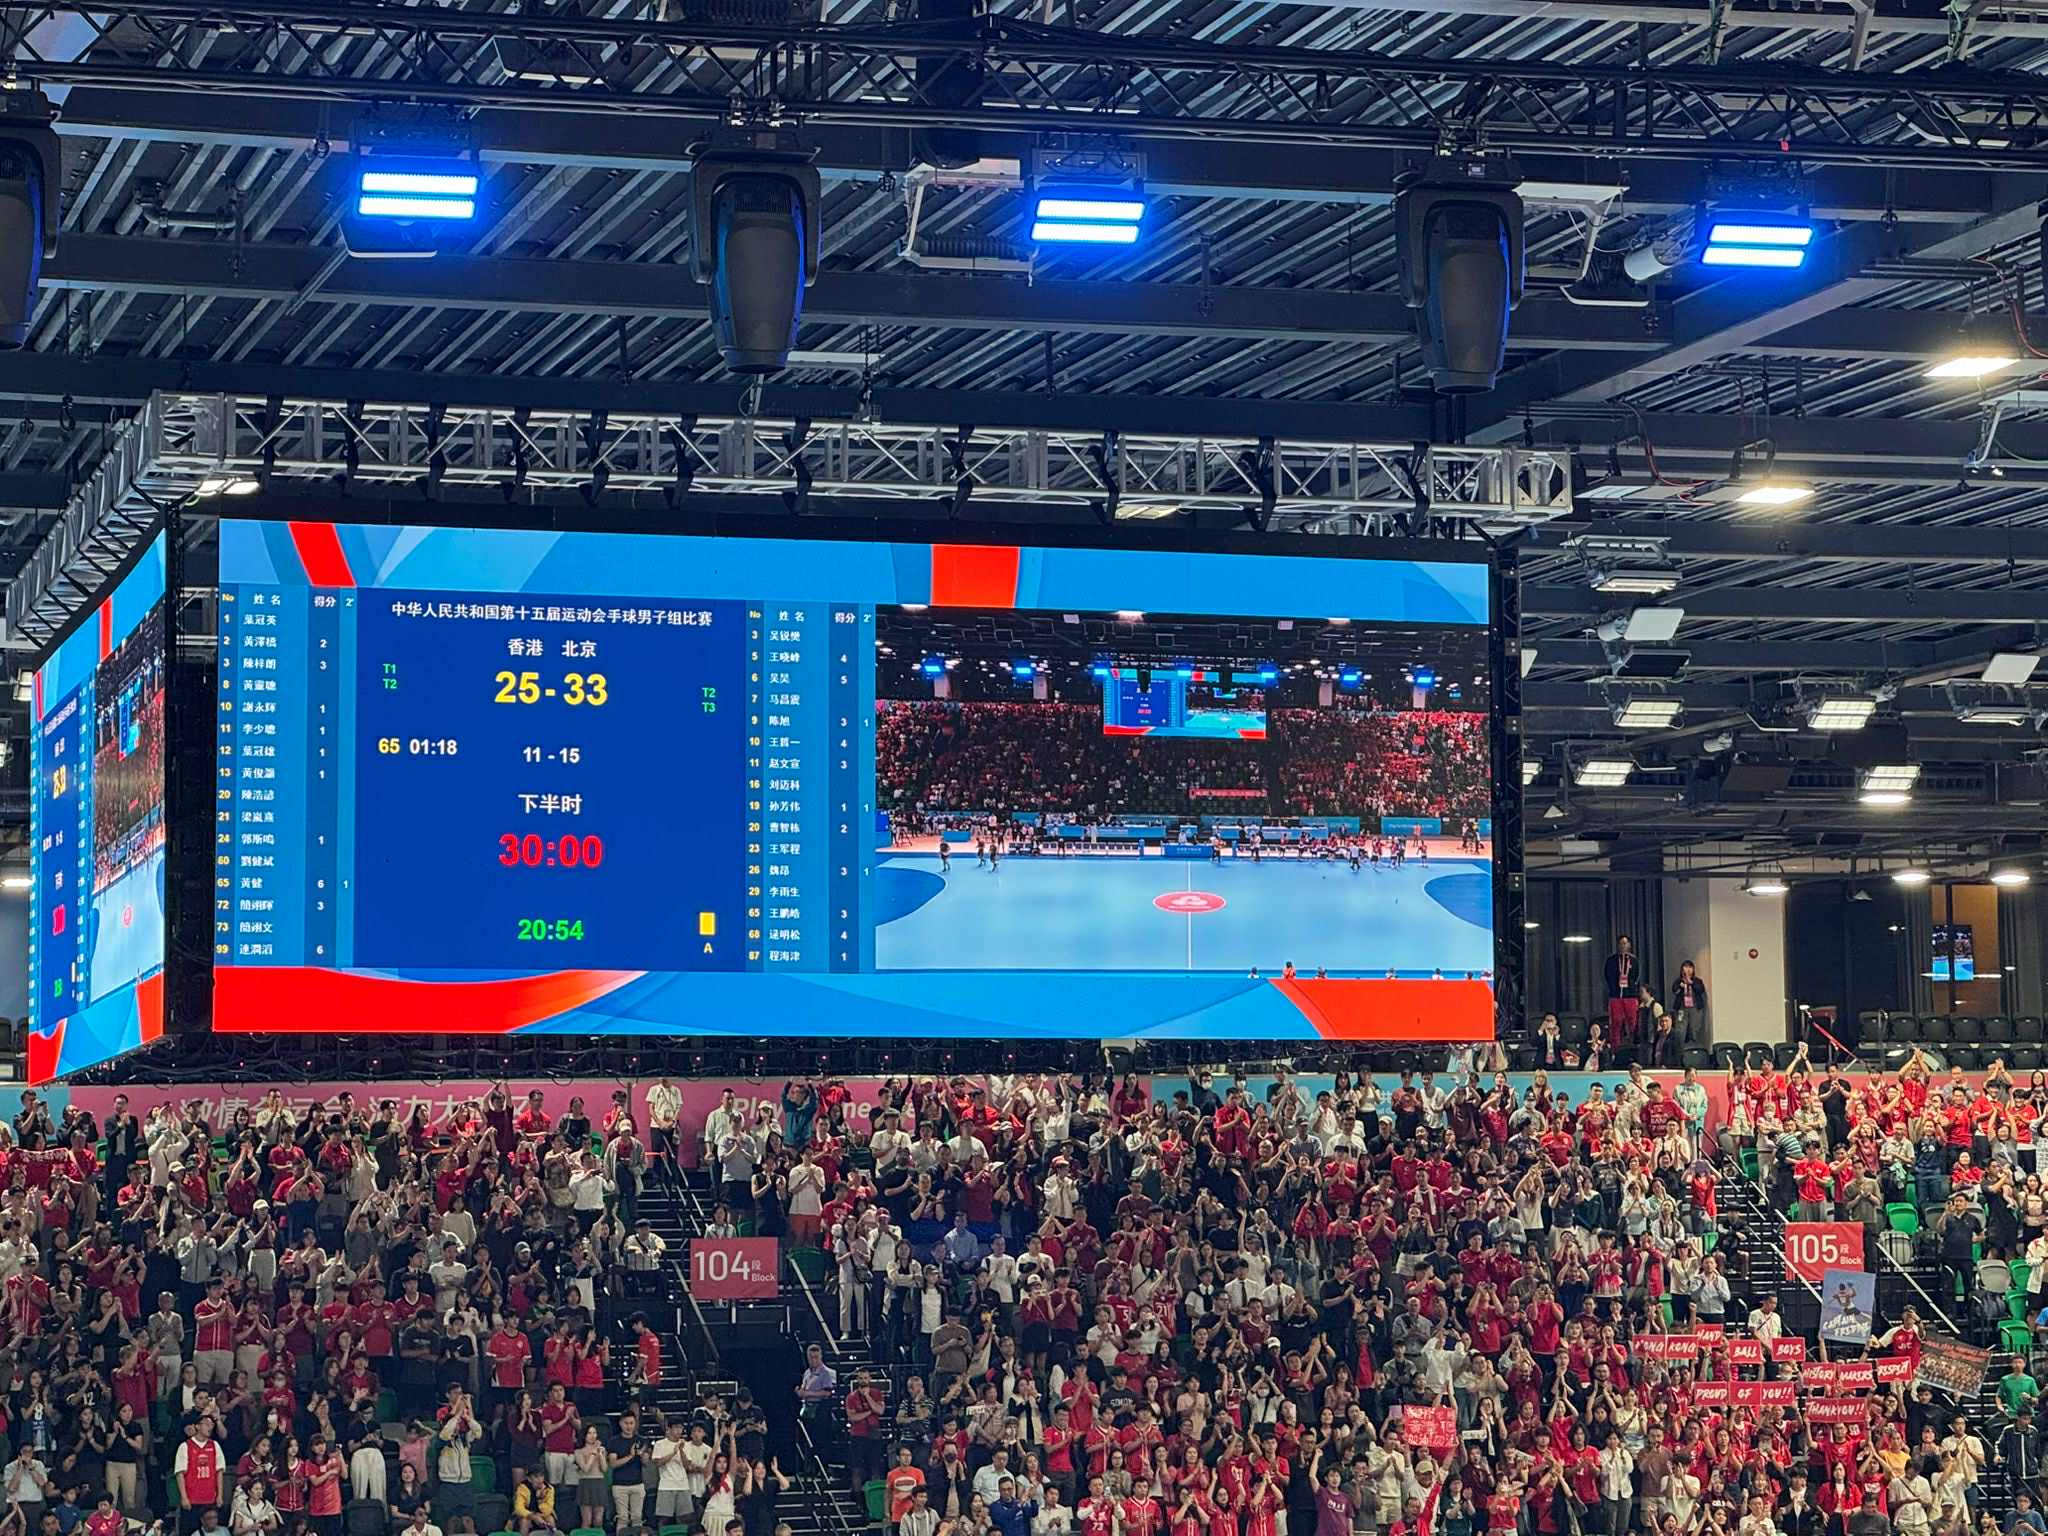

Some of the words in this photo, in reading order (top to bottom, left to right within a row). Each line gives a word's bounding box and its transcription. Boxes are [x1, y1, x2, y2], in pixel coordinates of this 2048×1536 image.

[253, 594, 281, 605] 姓名
[314, 596, 336, 607] 得分
[224, 614, 230, 623] 1
[391, 601, 713, 627] 中华人民共和国第十五届运动会手球男子组比赛
[779, 611, 804, 622] 姓名
[834, 613, 855, 623] 得分
[752, 630, 758, 639] 3
[224, 636, 231, 645] 2
[508, 638, 544, 656] 香港
[561, 640, 597, 658] 北京
[752, 652, 758, 660] 5
[224, 658, 230, 667] 3
[383, 664, 397, 675] T1
[752, 673, 758, 682] 6
[383, 678, 398, 690] T2
[702, 687, 716, 698] T2
[752, 694, 758, 703] 7
[220, 702, 232, 711] 10
[702, 702, 716, 713] T3
[220, 724, 231, 733] 11
[749, 737, 760, 746] 10
[219, 746, 232, 755] 12
[378, 738, 400, 754] 65
[409, 738, 458, 756] 01:18
[523, 747, 541, 763] 11
[559, 748, 581, 763] 15
[749, 759, 759, 767] 11
[219, 768, 231, 777] 13
[218, 790, 231, 799] 20
[518, 793, 583, 815] 下半时
[749, 801, 760, 810] 19
[218, 812, 230, 821] 21
[749, 823, 760, 832] 20
[498, 833, 603, 868] 30:00
[749, 844, 760, 853] 23
[749, 865, 760, 874] 26
[217, 878, 230, 887] 65
[749, 887, 760, 896] 29
[217, 900, 229, 909] 72
[749, 908, 760, 917] 65
[217, 922, 229, 931] 73
[517, 919, 584, 941] 20:54
[703, 942, 713, 954] A
[1789, 1234, 1839, 1264] 105
[1840, 1256, 1862, 1265] Block
[694, 1250, 750, 1281] 104
[752, 1273, 776, 1281] Block
[1668, 1341, 1697, 1353] KONG
[1733, 1346, 1758, 1358] BALL
[1776, 1344, 1801, 1356] BOYS
[1696, 1388, 1728, 1400] PROUD
[1737, 1387, 1752, 1399] OF
[1762, 1387, 1792, 1400] YOU!!
